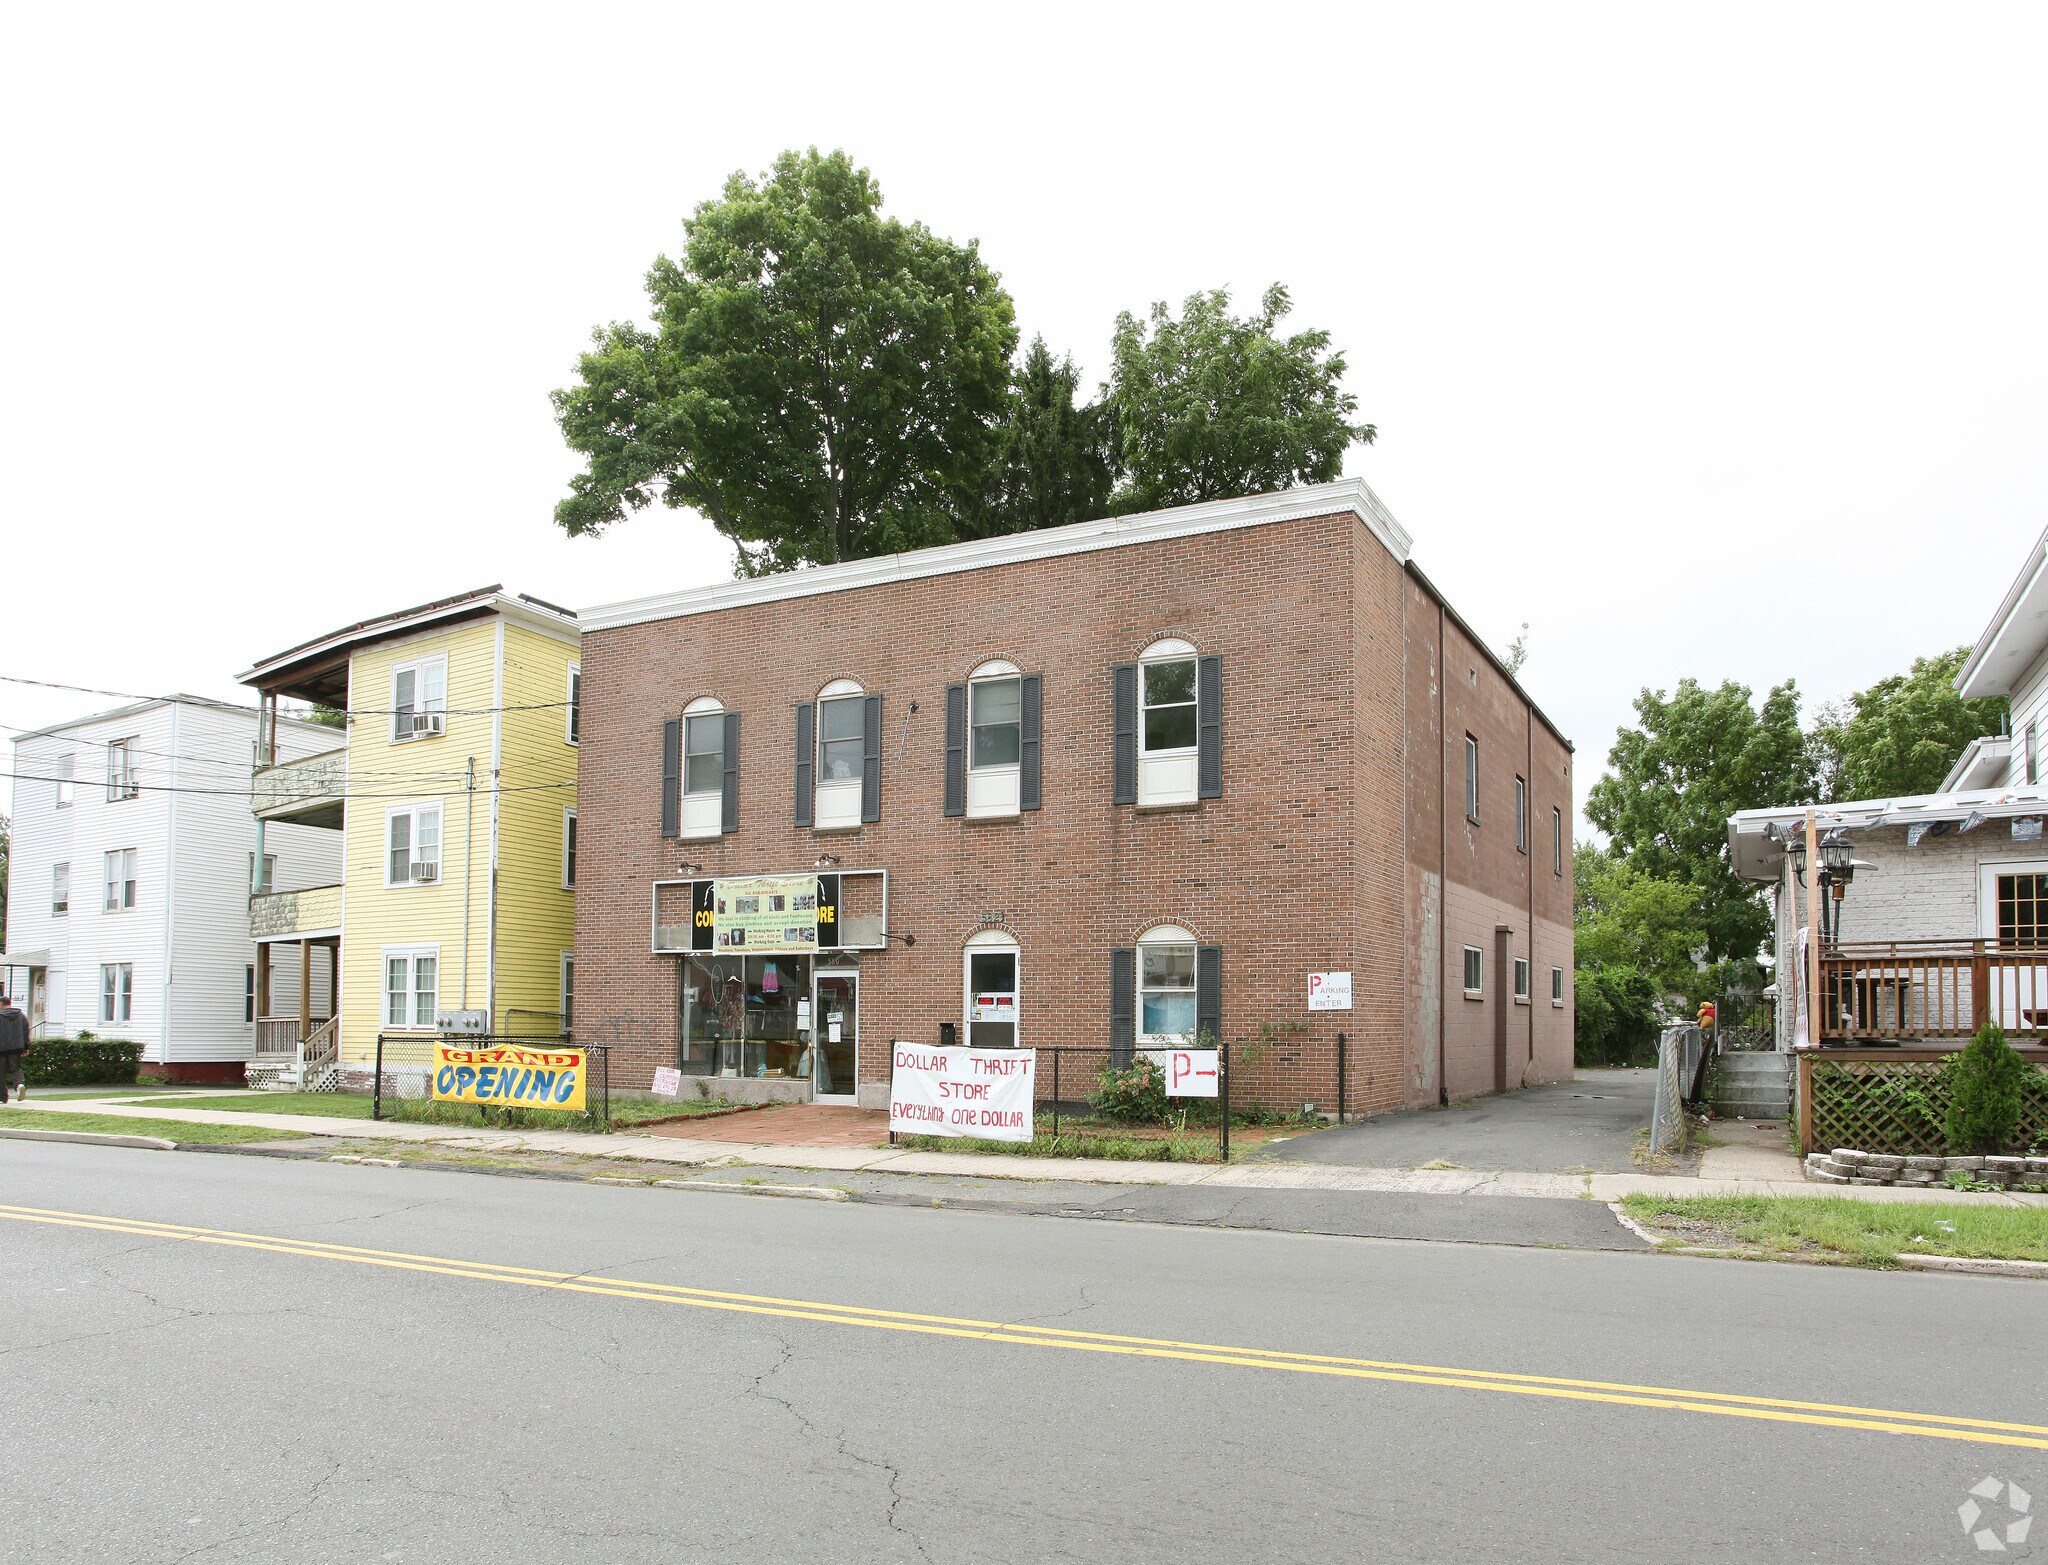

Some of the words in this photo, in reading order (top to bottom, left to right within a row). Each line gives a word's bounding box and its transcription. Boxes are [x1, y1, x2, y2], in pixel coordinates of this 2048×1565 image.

[727, 882, 752, 890] Dollar
[755, 879, 780, 890] Thrift
[782, 878, 804, 887] Store
[1310, 976, 1350, 995] PARKING
[447, 1050, 572, 1066] GRAND
[896, 1052, 947, 1072] DOLLAR
[970, 1058, 1032, 1075] THRIFT
[1174, 1053, 1191, 1088] P
[436, 1064, 576, 1103] OPENING
[939, 1082, 991, 1100] STORE
[982, 1110, 1024, 1127] DOLLAR
